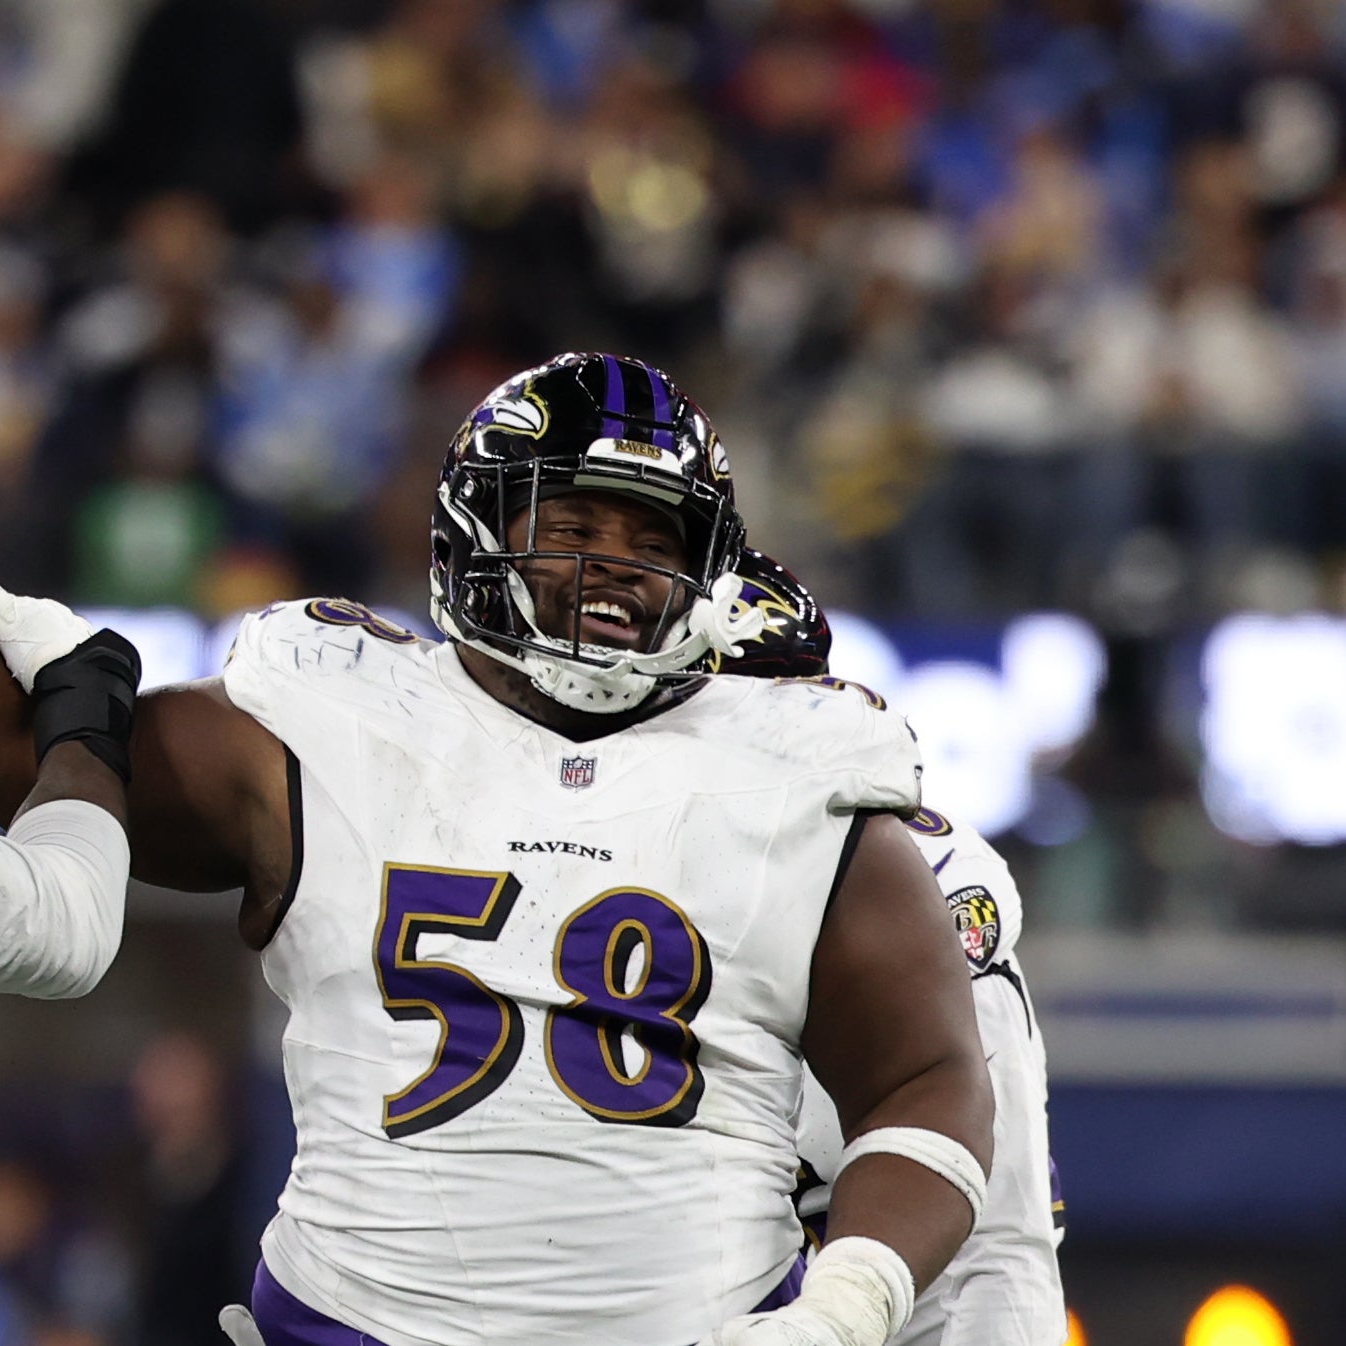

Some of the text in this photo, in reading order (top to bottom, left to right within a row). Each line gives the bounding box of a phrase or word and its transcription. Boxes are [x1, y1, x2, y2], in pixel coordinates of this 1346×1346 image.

[614, 438, 663, 460] RAVENS
[507, 840, 613, 862] RAVENS
[947, 887, 985, 908] AVENS
[372, 860, 713, 1140] 58
